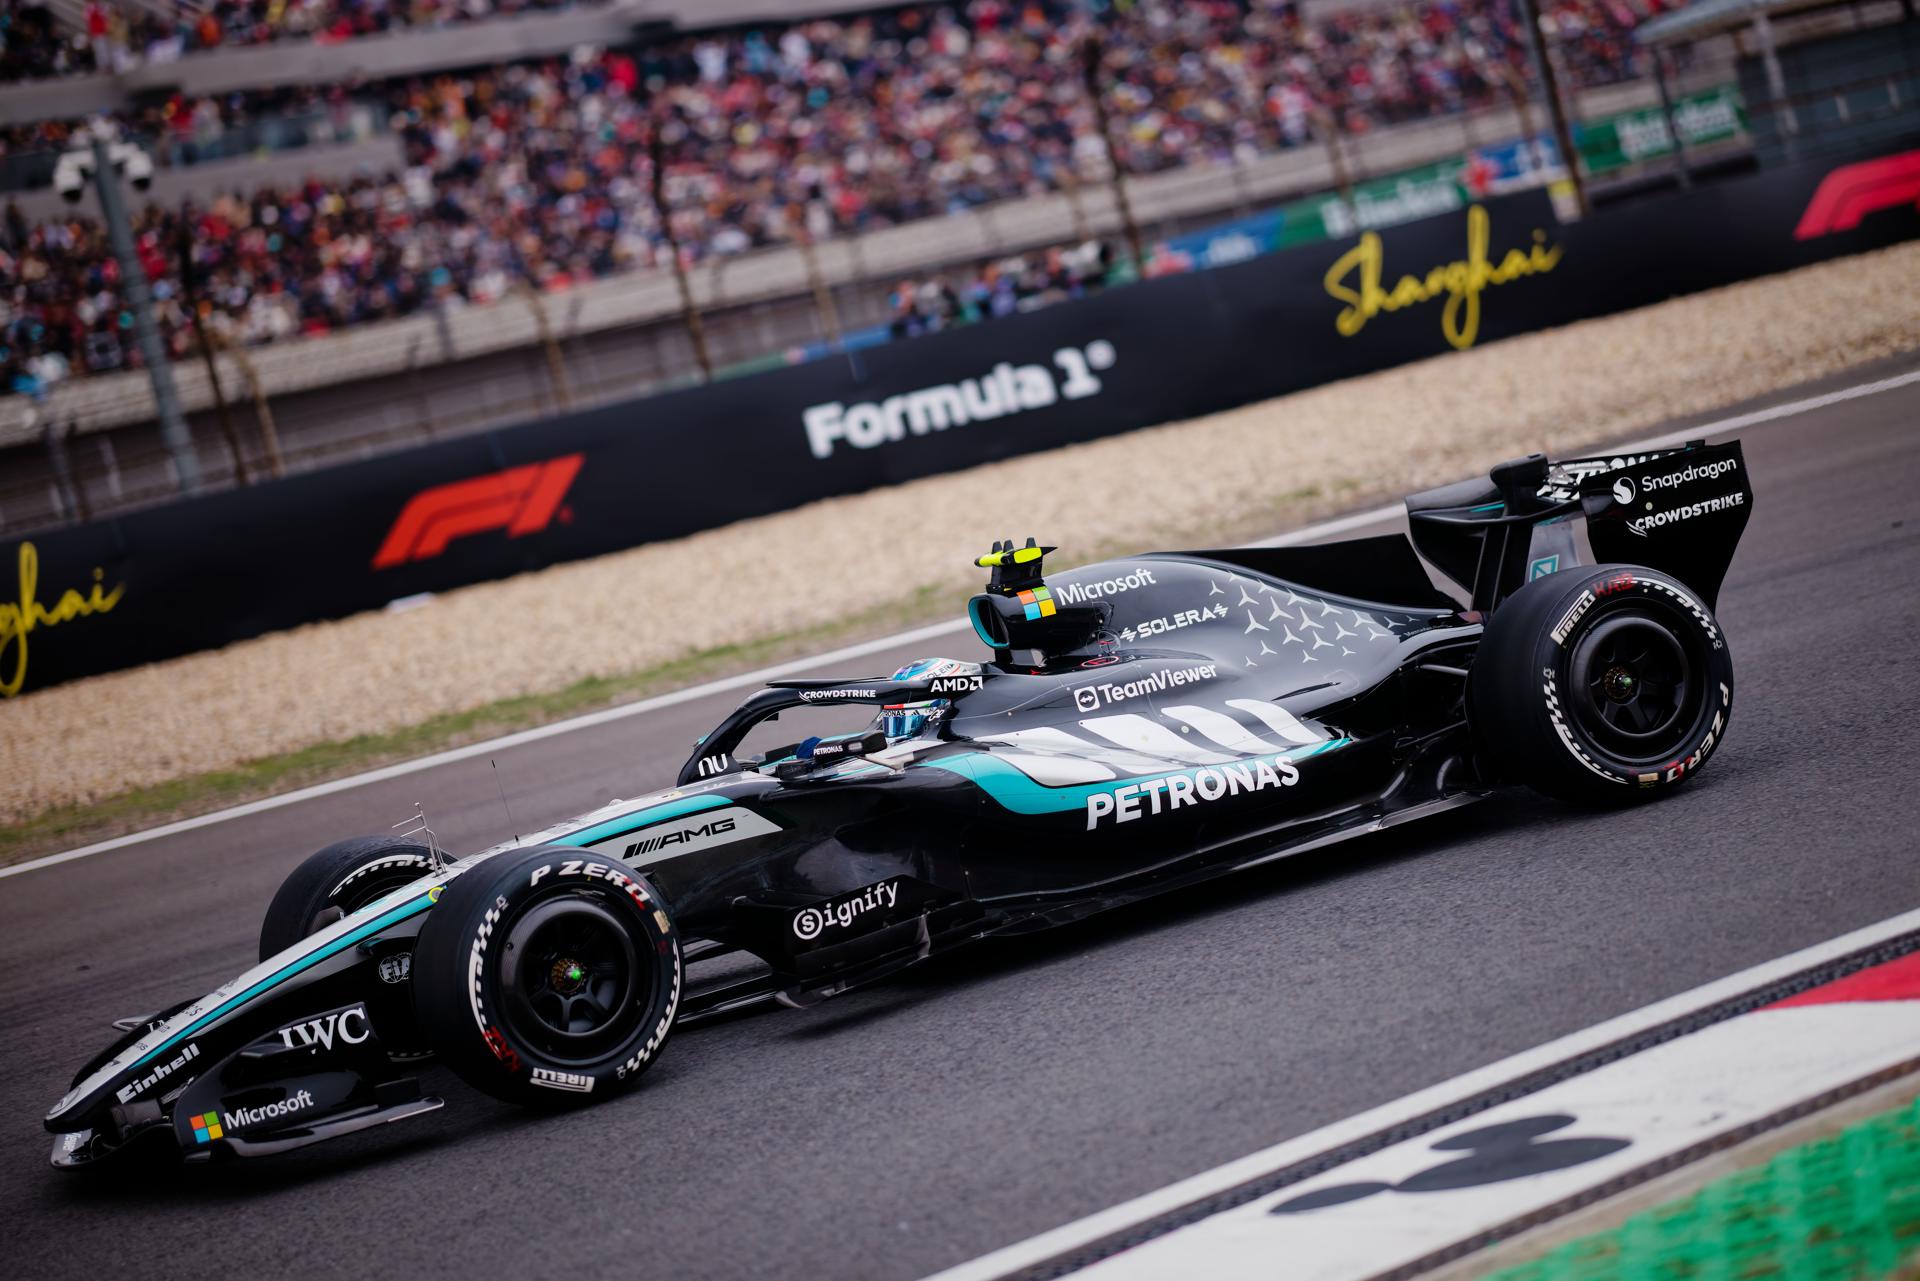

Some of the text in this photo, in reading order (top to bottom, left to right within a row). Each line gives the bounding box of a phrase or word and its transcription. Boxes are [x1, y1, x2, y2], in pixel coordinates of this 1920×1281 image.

[803, 362, 1056, 458] Formula
[1641, 458, 1737, 491] Snapdragon
[1635, 492, 1744, 530] CROWDSTRIKE
[1056, 568, 1156, 606] Microsoft
[1137, 609, 1217, 639] SOLERA
[1550, 589, 1596, 645] PIRELLI
[803, 689, 876, 700] CROWDSTRIKE
[930, 678, 969, 693] AMD
[1097, 663, 1218, 704] TeamViewer
[813, 744, 843, 756] PETRONAS
[1666, 682, 1729, 783] P ZERO
[698, 753, 728, 776] nu
[1086, 756, 1300, 831] PETRONAS
[658, 818, 736, 850] AMG
[530, 860, 651, 903] P ZERO
[278, 1008, 370, 1055] IWC
[116, 1043, 200, 1104] Einhell
[530, 1066, 595, 1093] PIRELLI
[224, 1089, 314, 1131] Microsoft
